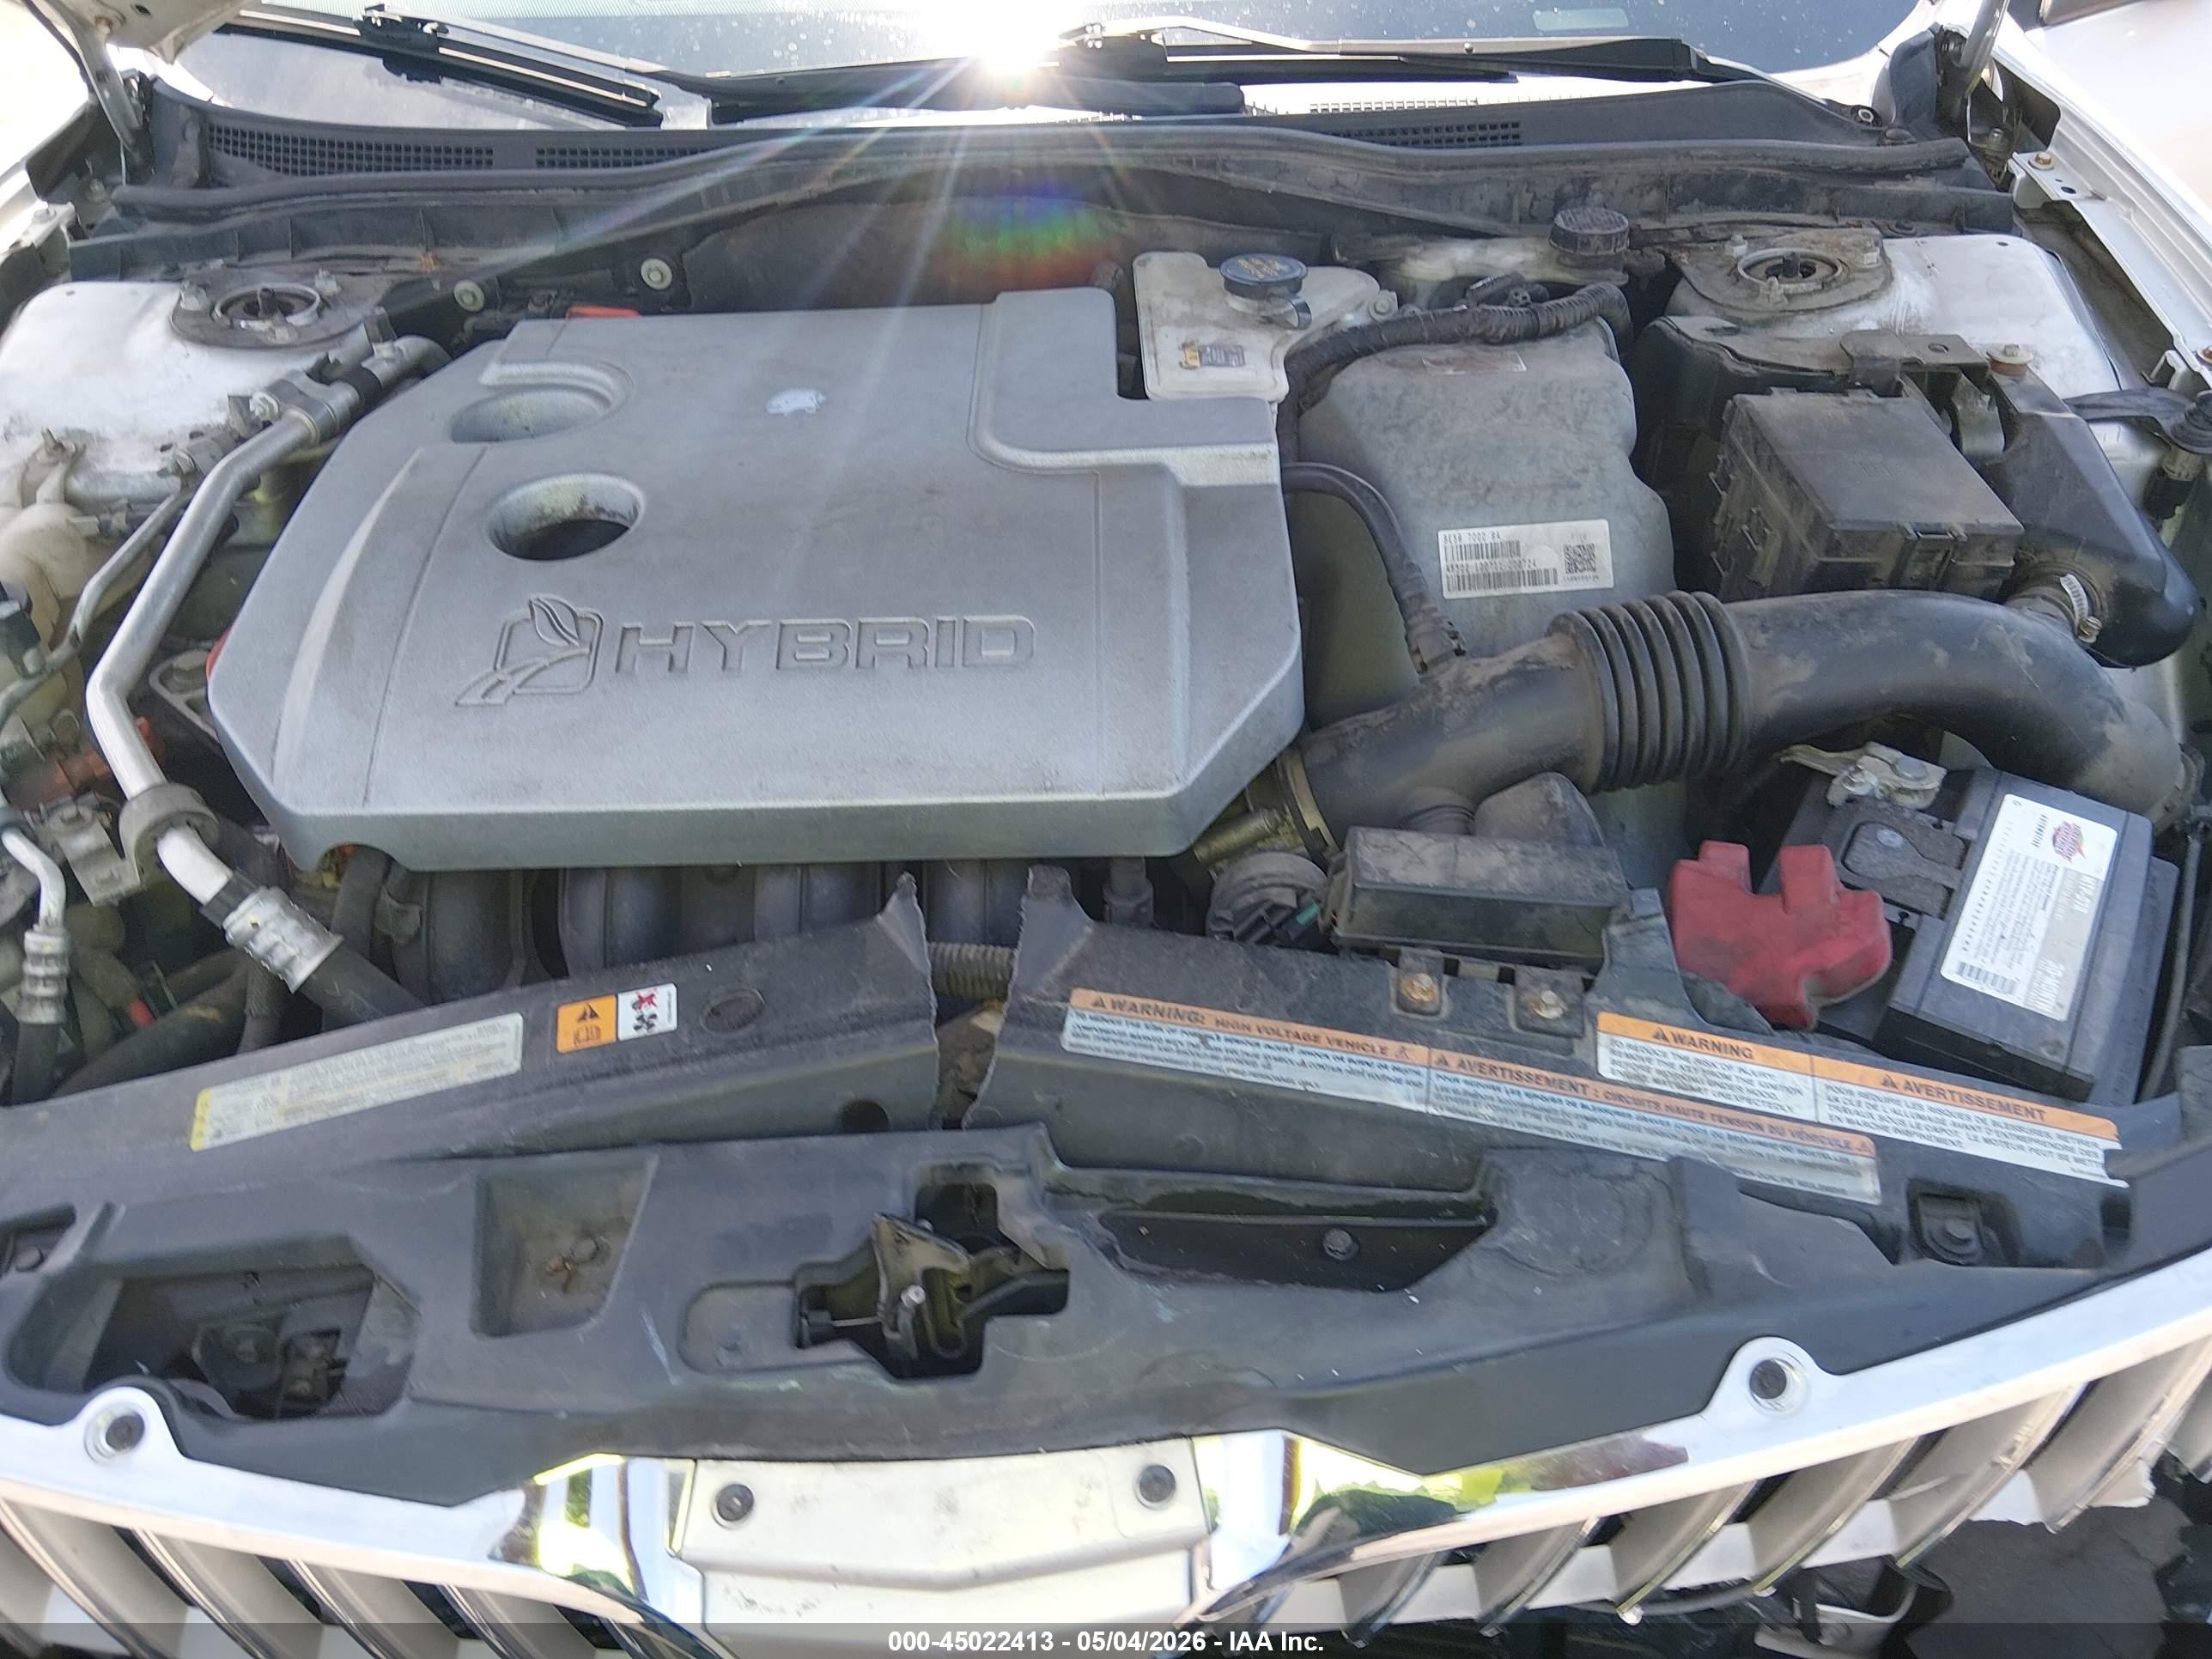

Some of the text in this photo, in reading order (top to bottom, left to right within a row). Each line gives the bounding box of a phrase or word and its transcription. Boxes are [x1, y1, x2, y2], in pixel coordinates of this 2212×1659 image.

[615, 616, 1036, 672] HYBRID
[1110, 1000, 1389, 1056] WARNING: HIGH VOLTAGE VEHICLE
[1671, 1032, 1753, 1059] WARNING
[1458, 1056, 1589, 1097] AVERTISSEMENT
[1603, 1090, 1662, 1110] CIRCUITS
[1709, 1112, 1764, 1132] TENSION
[1903, 1079, 2046, 1121] AVERTISSEMENT
